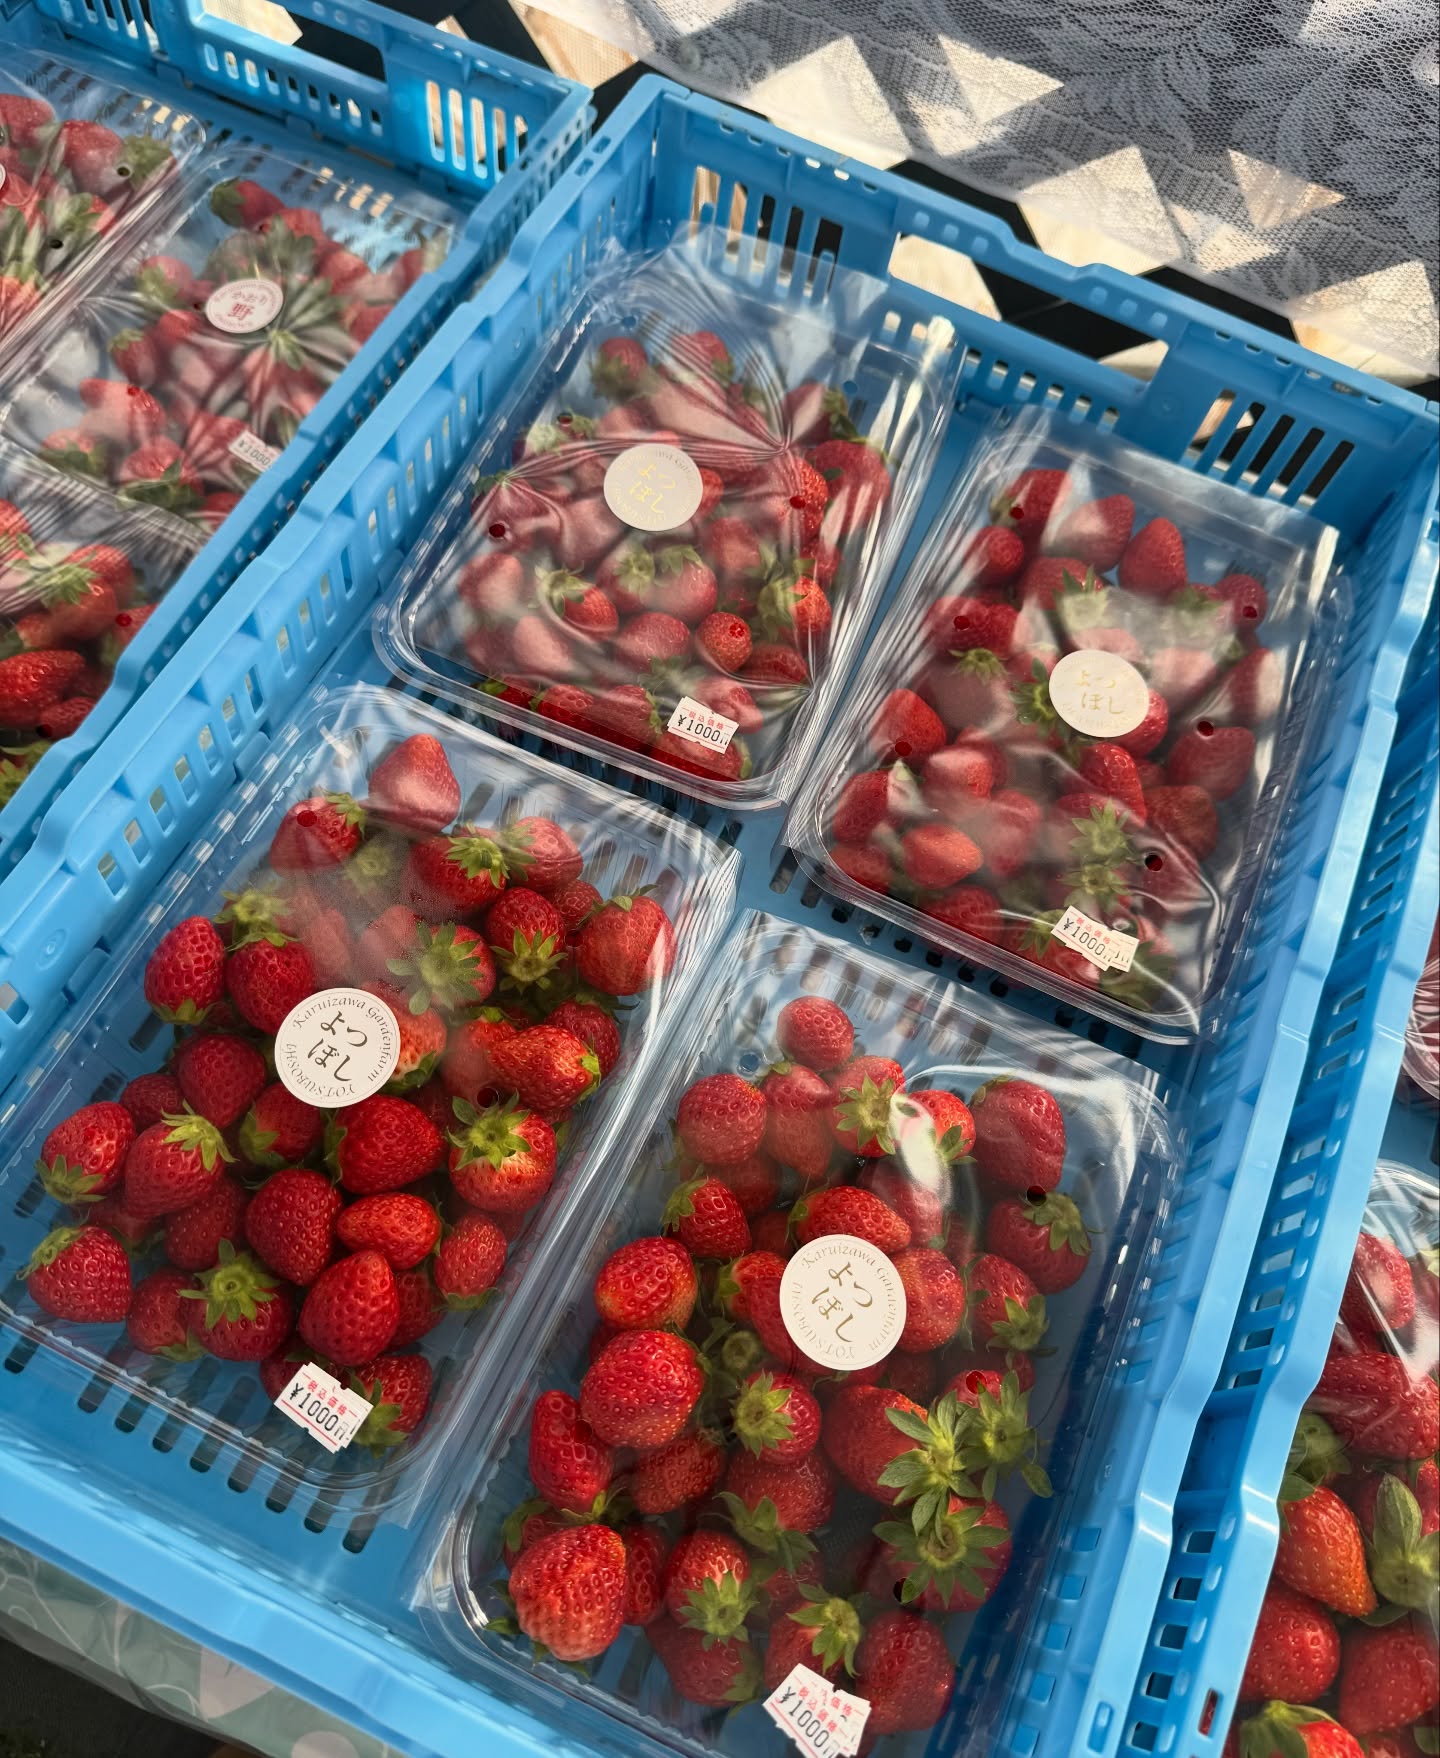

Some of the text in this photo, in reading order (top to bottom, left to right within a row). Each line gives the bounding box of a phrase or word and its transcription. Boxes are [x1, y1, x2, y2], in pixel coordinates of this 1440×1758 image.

[293, 996, 366, 1029] Karuizawa
[320, 1010, 368, 1047] よつ
[307, 1038, 353, 1082] ぼし
[802, 1242, 876, 1269] Karuizawa
[828, 1261, 873, 1308] よつ
[811, 1286, 854, 1343] ぼし
